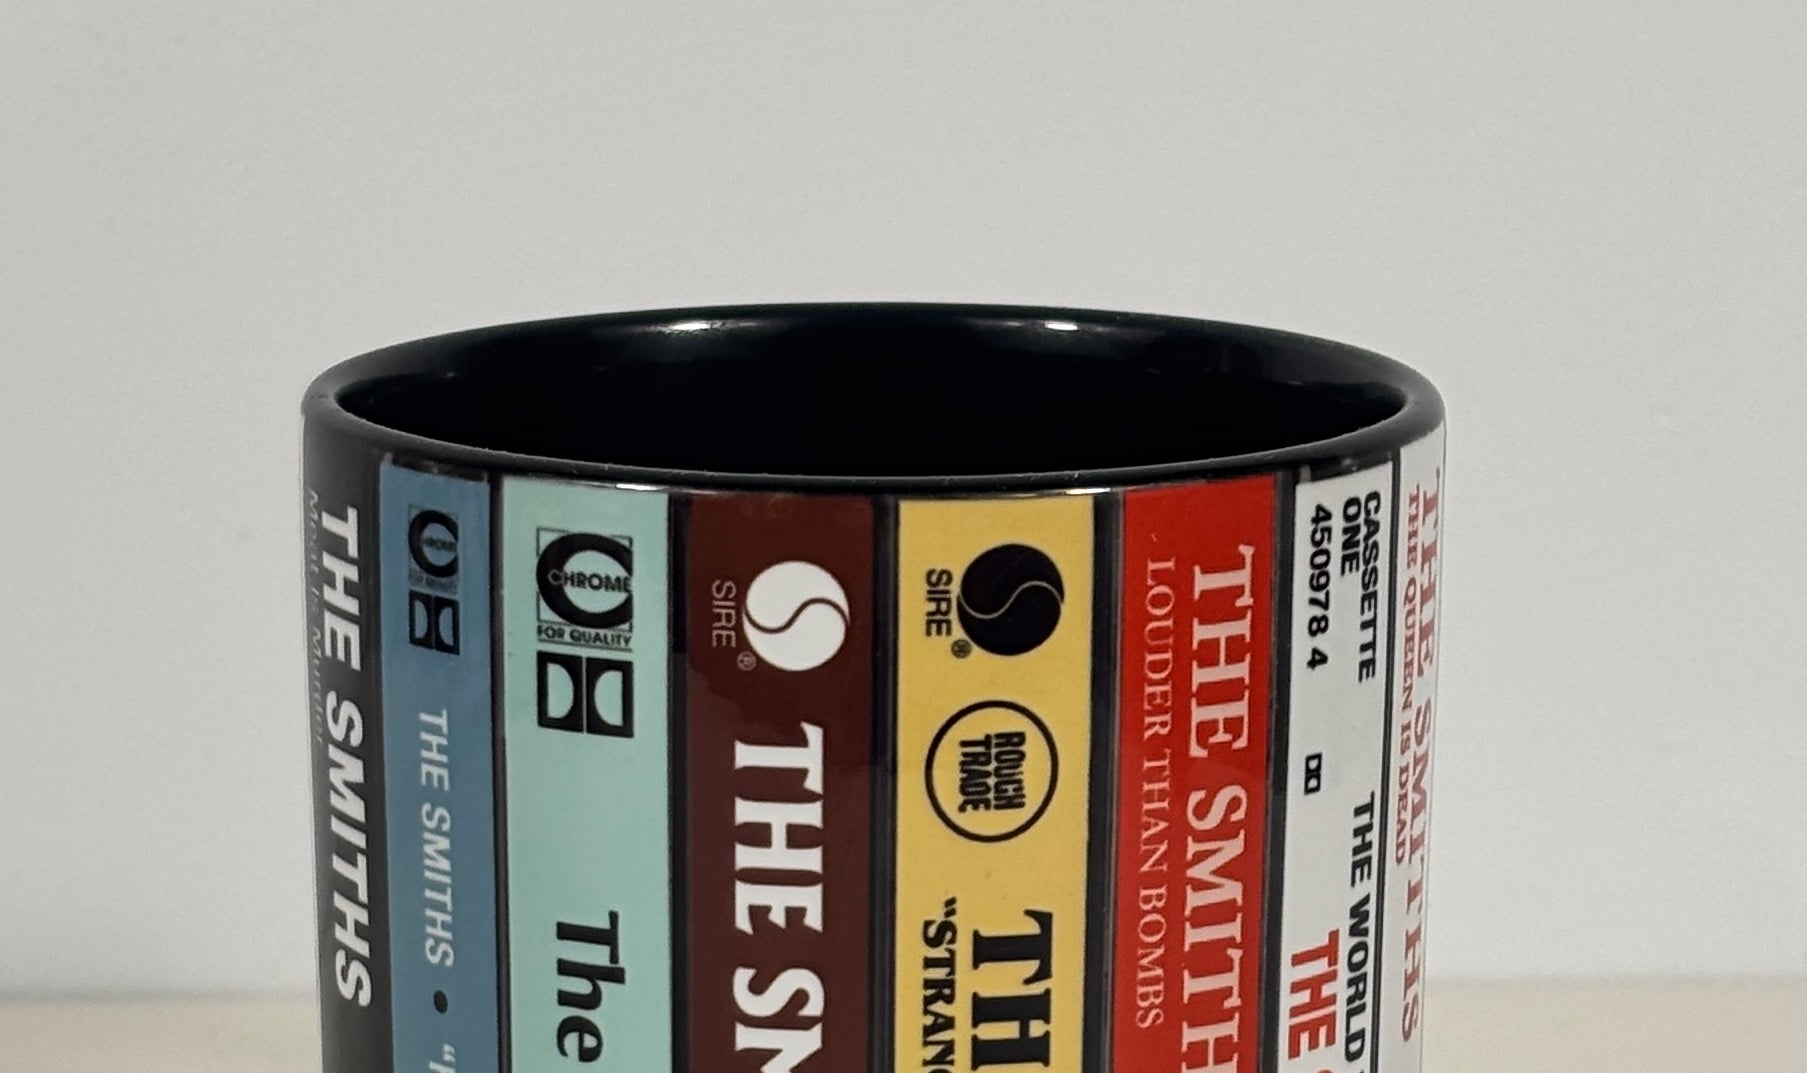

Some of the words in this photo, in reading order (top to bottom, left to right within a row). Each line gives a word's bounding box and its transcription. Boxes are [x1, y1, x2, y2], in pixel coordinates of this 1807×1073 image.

[322, 506, 361, 672] THE
[548, 569, 632, 593] CHROME
[1308, 503, 1333, 638] 450978
[1340, 496, 1361, 577] ONE
[1358, 491, 1381, 683] CASSETTE
[1406, 483, 1420, 569] THE
[1417, 468, 1440, 678] THE
[538, 625, 565, 641] FOR
[570, 628, 632, 647] QUALITY
[711, 580, 736, 648] SIRE
[925, 568, 953, 637] SIRE
[1143, 556, 1176, 741] LOUDER
[1189, 544, 1254, 758] THE
[1306, 648, 1328, 671] 4
[1402, 576, 1418, 711] QUEEN
[418, 709, 450, 792] THE
[958, 733, 992, 813] TRADE
[993, 730, 1026, 811] ROUGH
[1400, 720, 1411, 756] IS
[326, 690, 372, 1007] SMITHS
[734, 721, 824, 935] THE
[1139, 748, 1170, 874] THAN
[1351, 790, 1375, 888] THE
[1395, 765, 1410, 865] DEAD
[1401, 699, 1432, 1043] SMITHS
[421, 803, 454, 967] SMITHS
[556, 910, 625, 1063] The
[1136, 884, 1168, 1029] BOMBS
[1288, 928, 1340, 1060] THE
[1345, 893, 1370, 1063] WORLD
